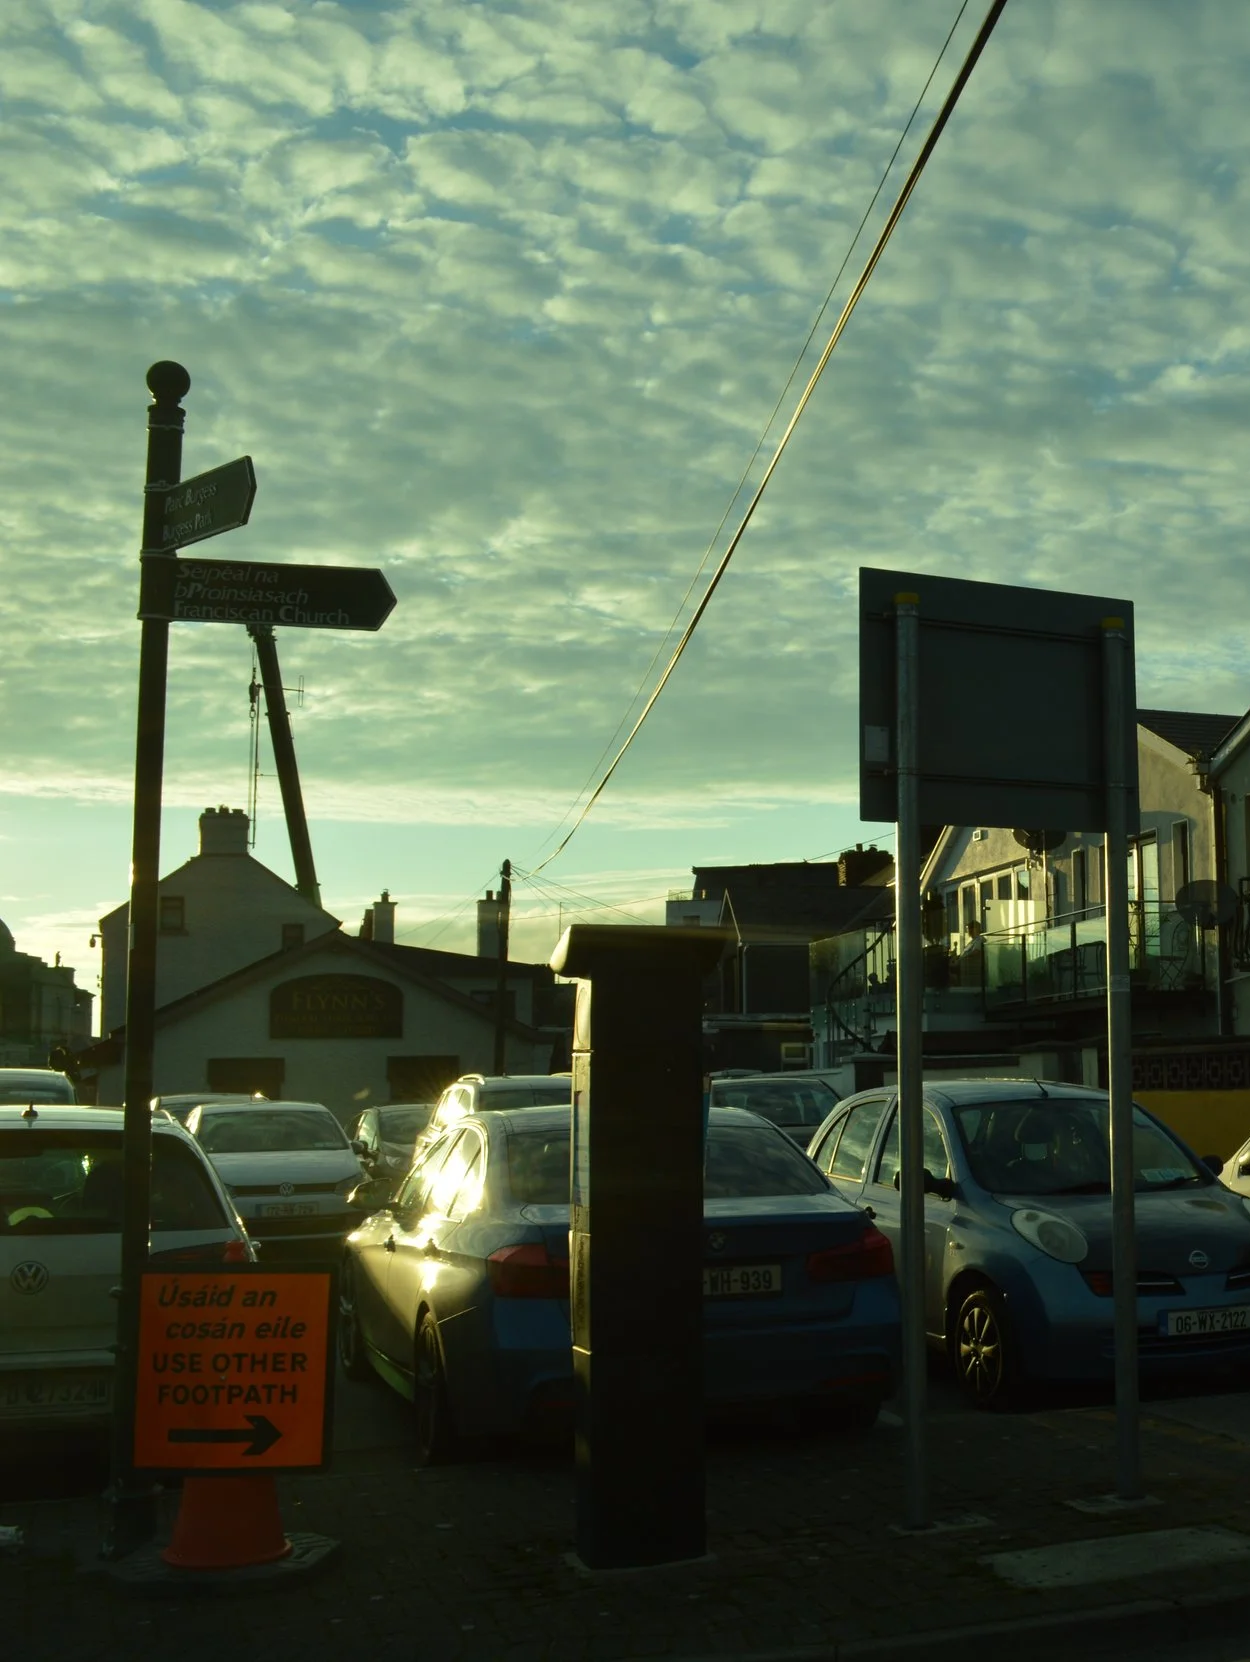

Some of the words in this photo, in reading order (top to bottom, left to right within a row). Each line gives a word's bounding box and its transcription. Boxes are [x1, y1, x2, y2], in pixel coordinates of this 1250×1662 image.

[165, 496, 182, 514] Parc
[185, 482, 217, 506] Burgess
[163, 521, 193, 542] Burgess
[195, 509, 212, 530] Park
[176, 562, 251, 584] Seipéal
[255, 570, 279, 583] na
[174, 582, 309, 604] bProinsiasach
[174, 601, 273, 621] Franciscan
[278, 605, 349, 625] Church
[292, 990, 387, 1012] FLYNN'S
[158, 1277, 236, 1308] Úsáid
[241, 1289, 278, 1307] an
[704, 1269, 772, 1293] -WH-939
[165, 1317, 246, 1340] cosán
[255, 1316, 308, 1339] eile
[1176, 1311, 1247, 1333] 06-WX-2122
[152, 1352, 203, 1373] USE
[211, 1352, 309, 1373] OTHER
[158, 1384, 298, 1405] FOOTPATH
